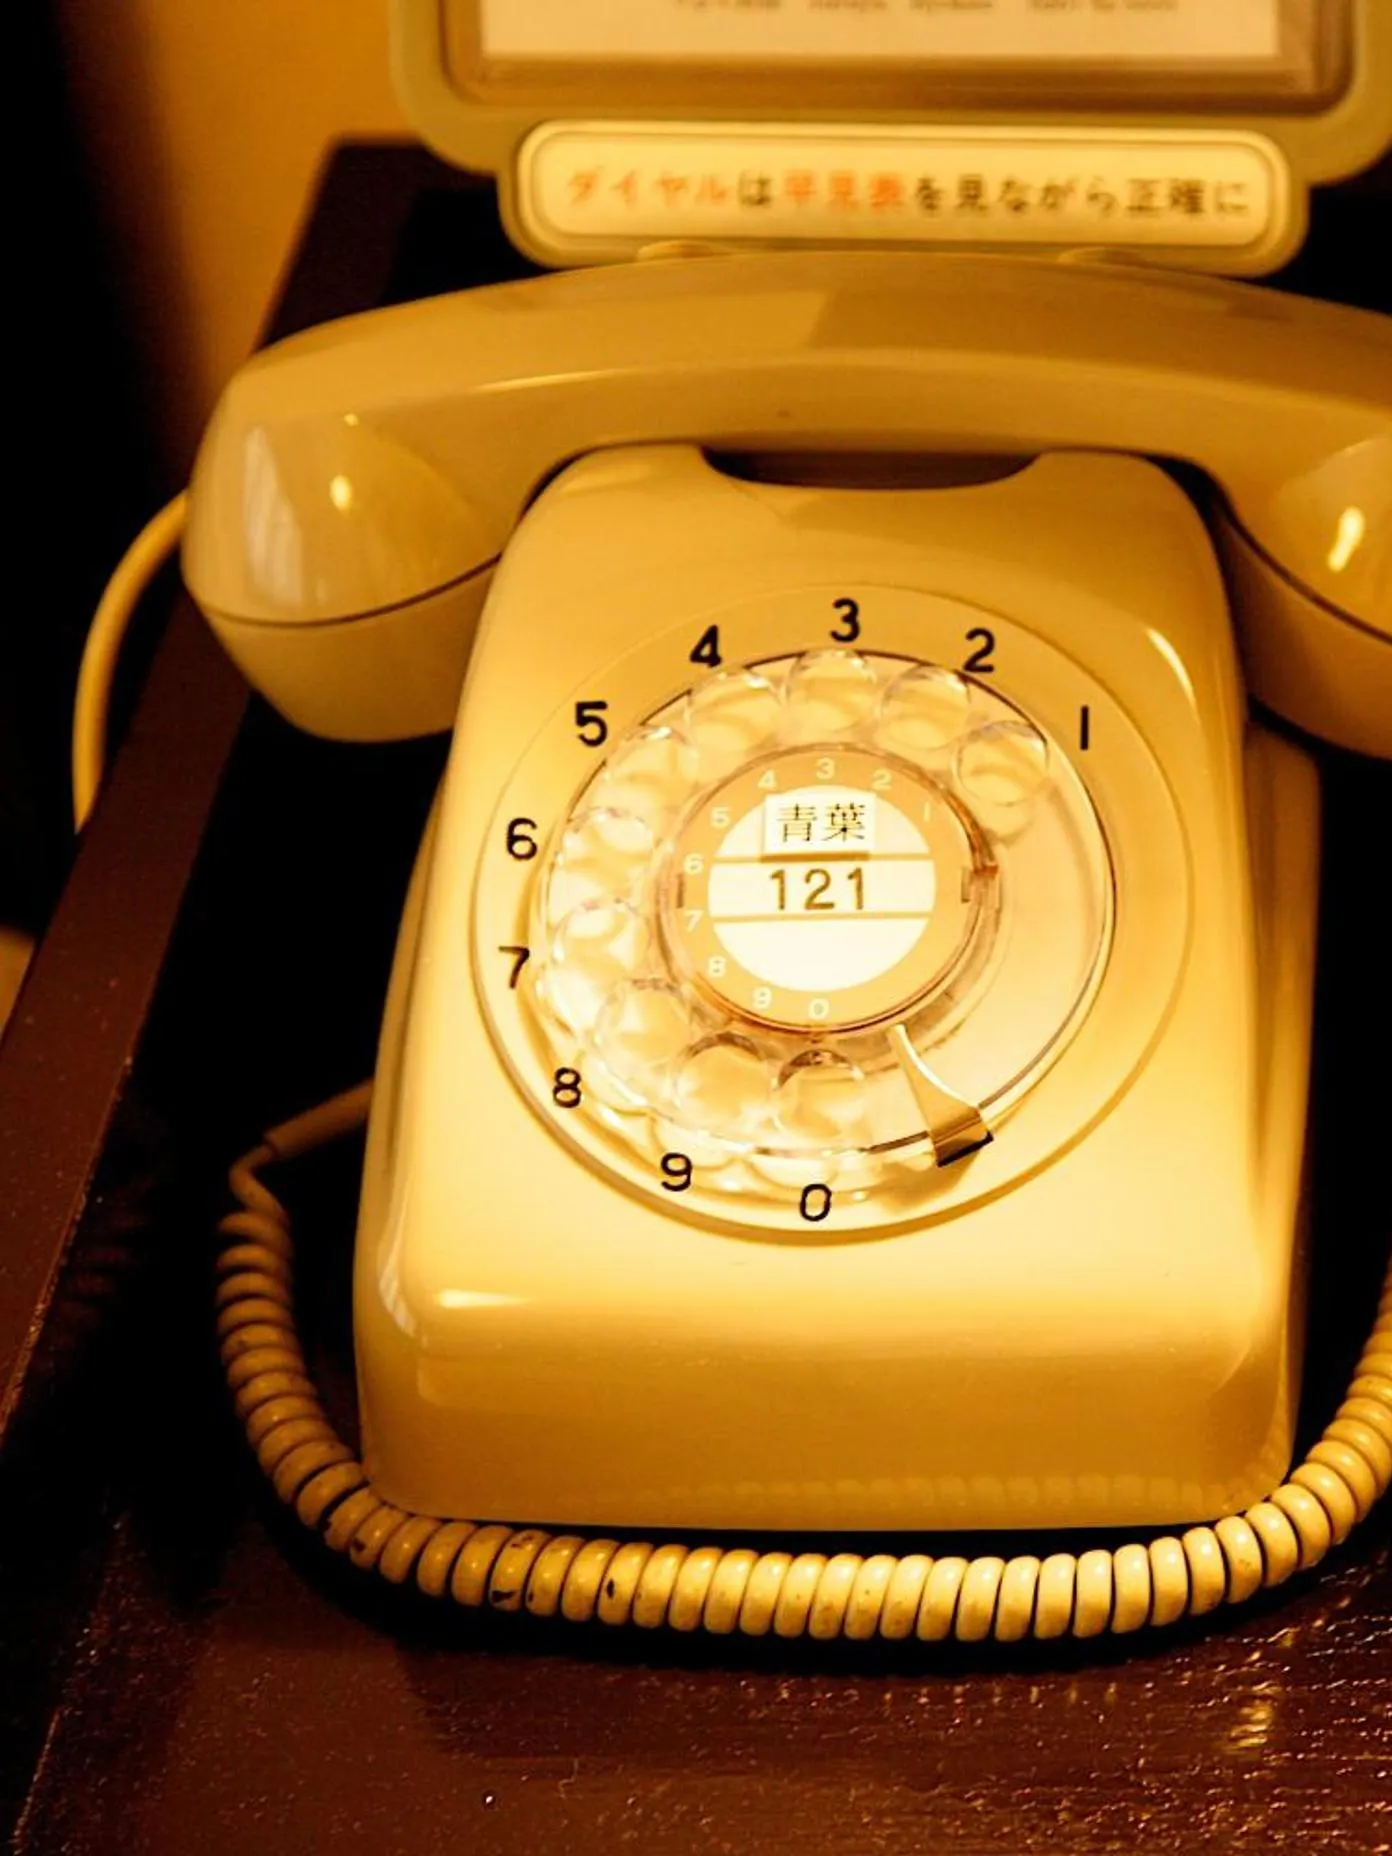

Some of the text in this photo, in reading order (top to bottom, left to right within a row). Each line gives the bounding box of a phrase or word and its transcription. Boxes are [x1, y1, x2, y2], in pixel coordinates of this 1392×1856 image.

[829, 598, 861, 642] 3
[689, 625, 722, 668] 4
[963, 628, 995, 673] 2
[574, 700, 609, 747] 5
[1079, 705, 1090, 751] 1
[757, 770, 777, 791] 4
[816, 757, 835, 779] 3
[872, 769, 893, 791] 2
[711, 806, 731, 828] 5
[777, 803, 867, 842] 青葉
[505, 818, 539, 861] 6
[684, 853, 704, 874] 6
[769, 867, 864, 911] 121
[684, 910, 703, 932] 7
[498, 945, 530, 990] 7
[707, 956, 727, 977] 8
[752, 987, 772, 1009] 9
[808, 997, 829, 1019] 0
[553, 1066, 582, 1108] 8
[660, 1151, 693, 1192] 9
[799, 1182, 833, 1222] 0
